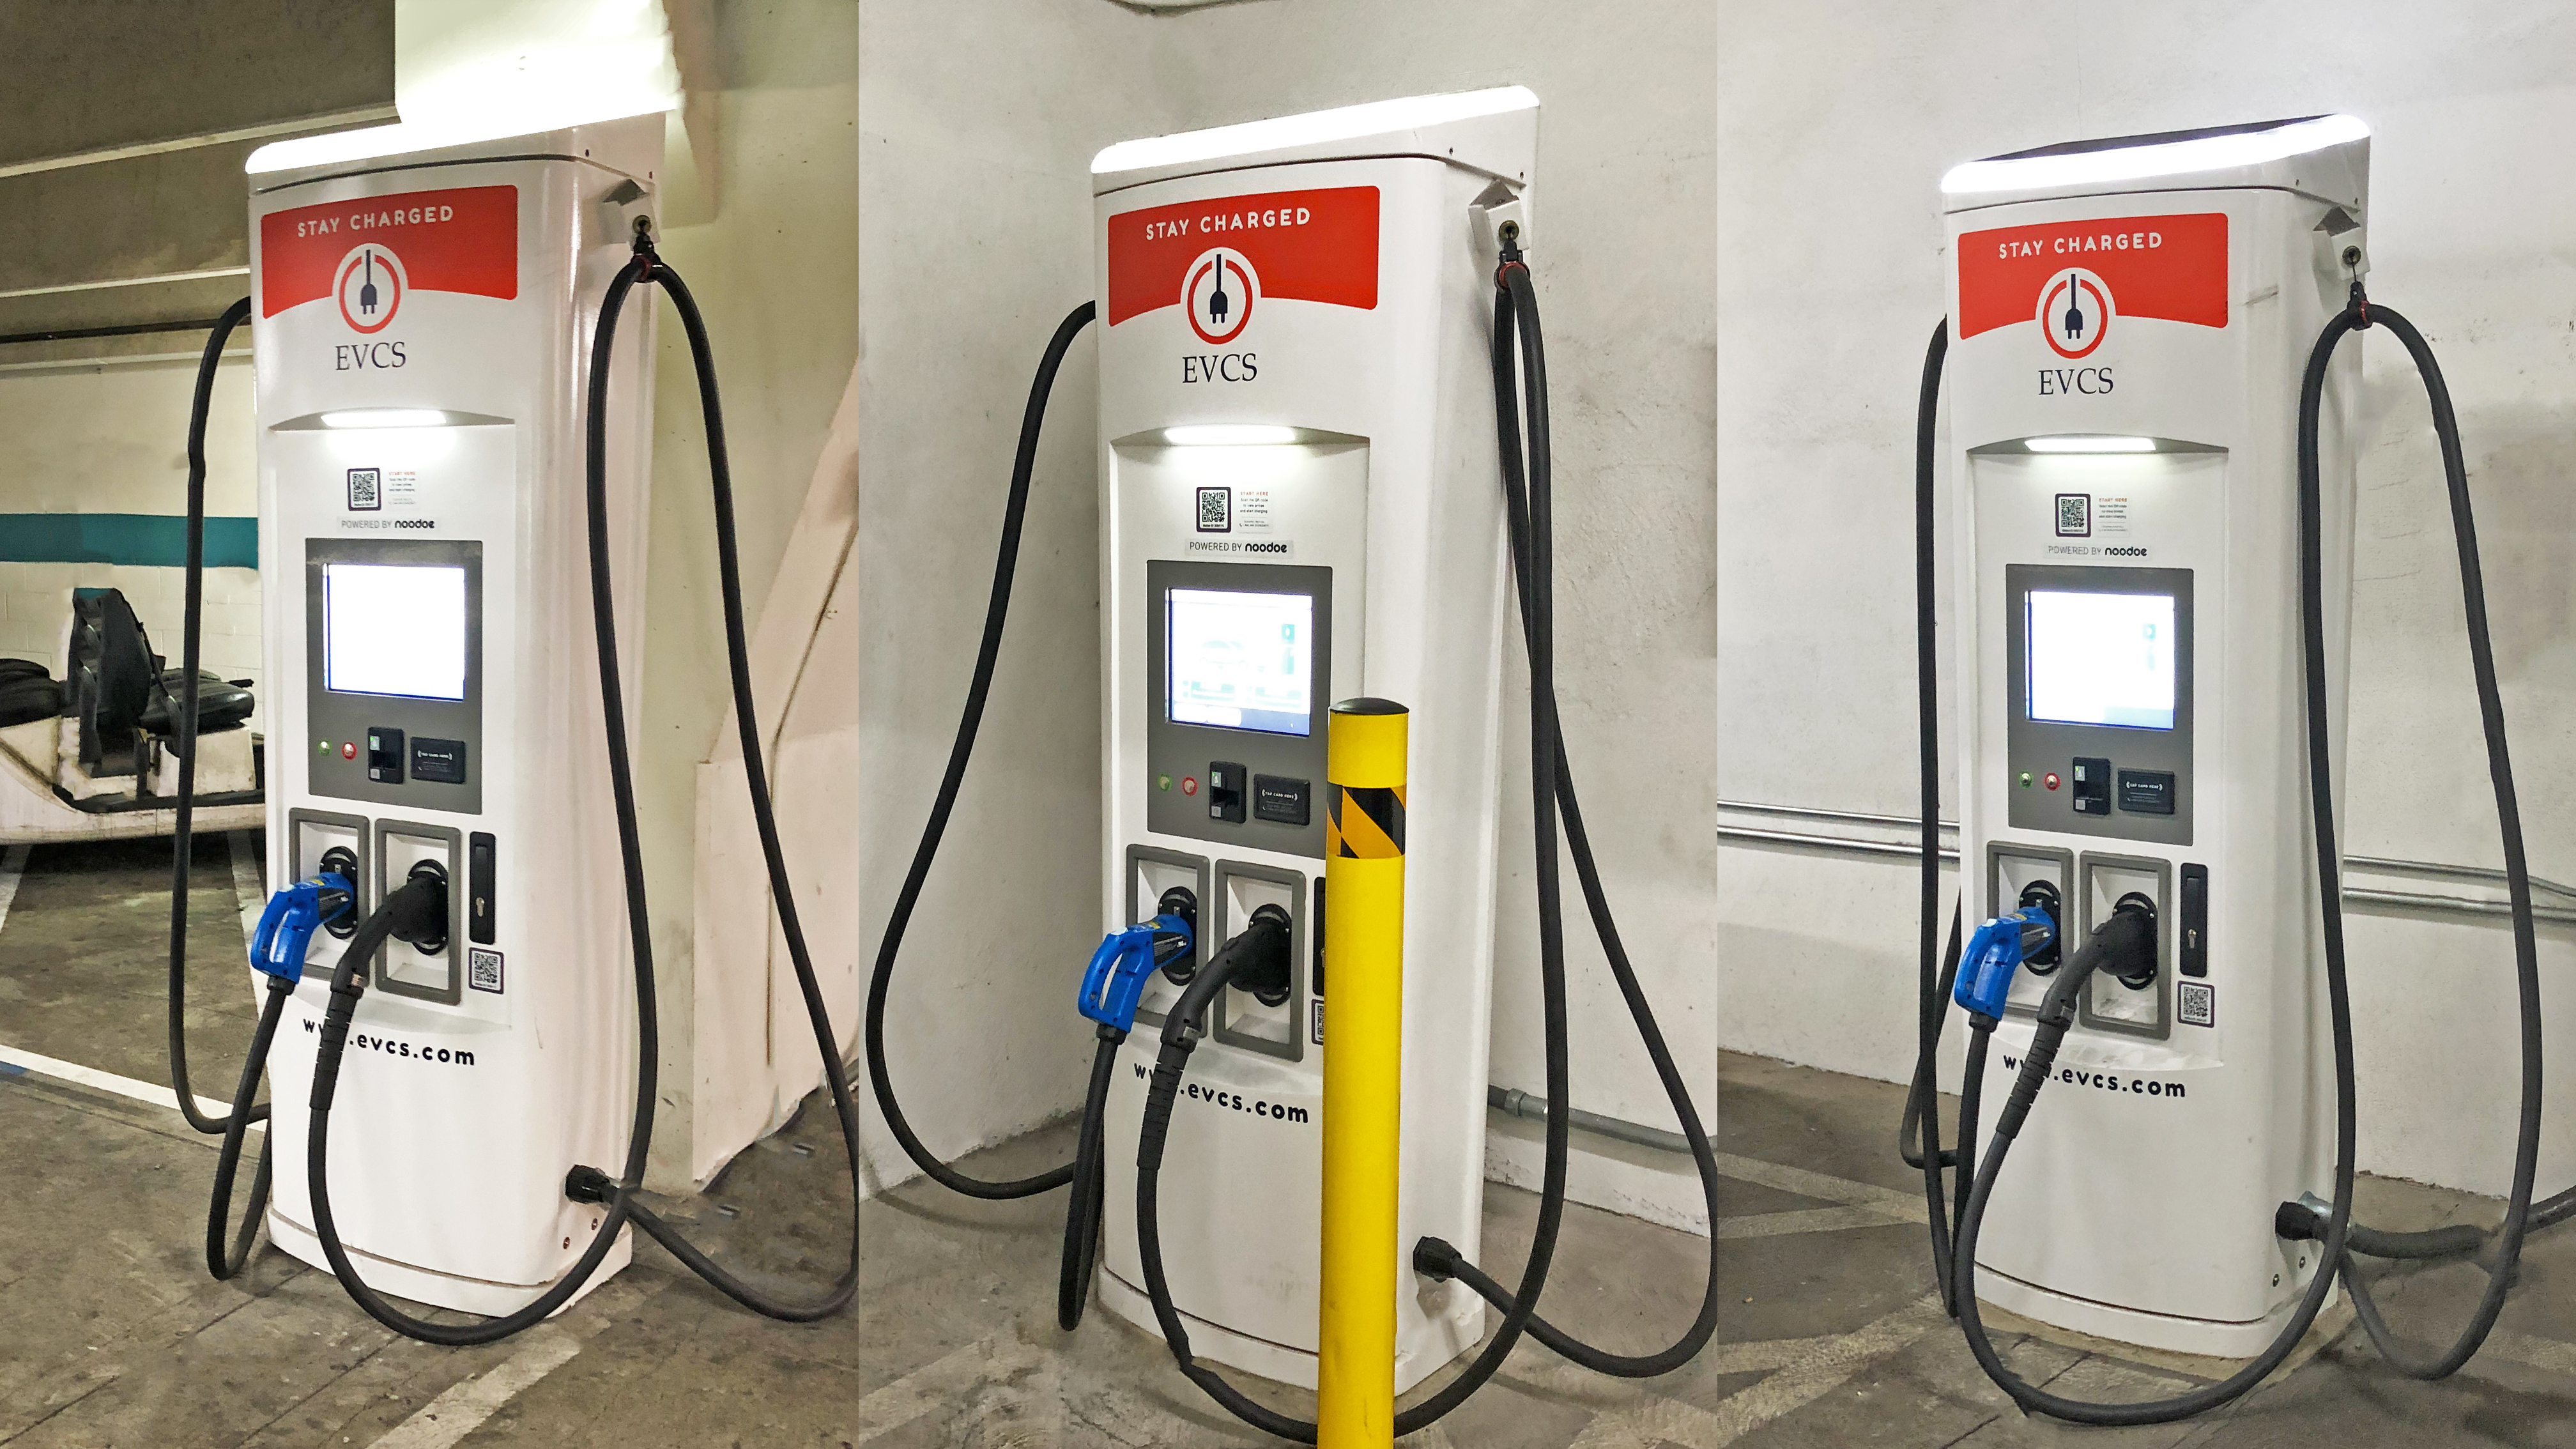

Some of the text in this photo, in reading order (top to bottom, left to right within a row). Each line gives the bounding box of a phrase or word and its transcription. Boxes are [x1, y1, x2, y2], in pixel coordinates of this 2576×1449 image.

[298, 206, 454, 238] STAY CHARGED
[1146, 208, 1311, 241] STAY CHARGED
[1999, 232, 2162, 259] STAY CHARGED
[335, 341, 407, 371] EVCS
[1182, 353, 1258, 384] EVCS
[2038, 367, 2114, 395] EVCS
[341, 518, 435, 529] POWERED BY noodoe
[1189, 541, 1287, 553] POWERED BY noodoe
[2048, 545, 2147, 556] POWERED BY noodoe
[303, 1018, 475, 1066] w.evcs.com
[2003, 1055, 2186, 1098] w.evcs.com
[1133, 1062, 1308, 1123] w.evcs.com
